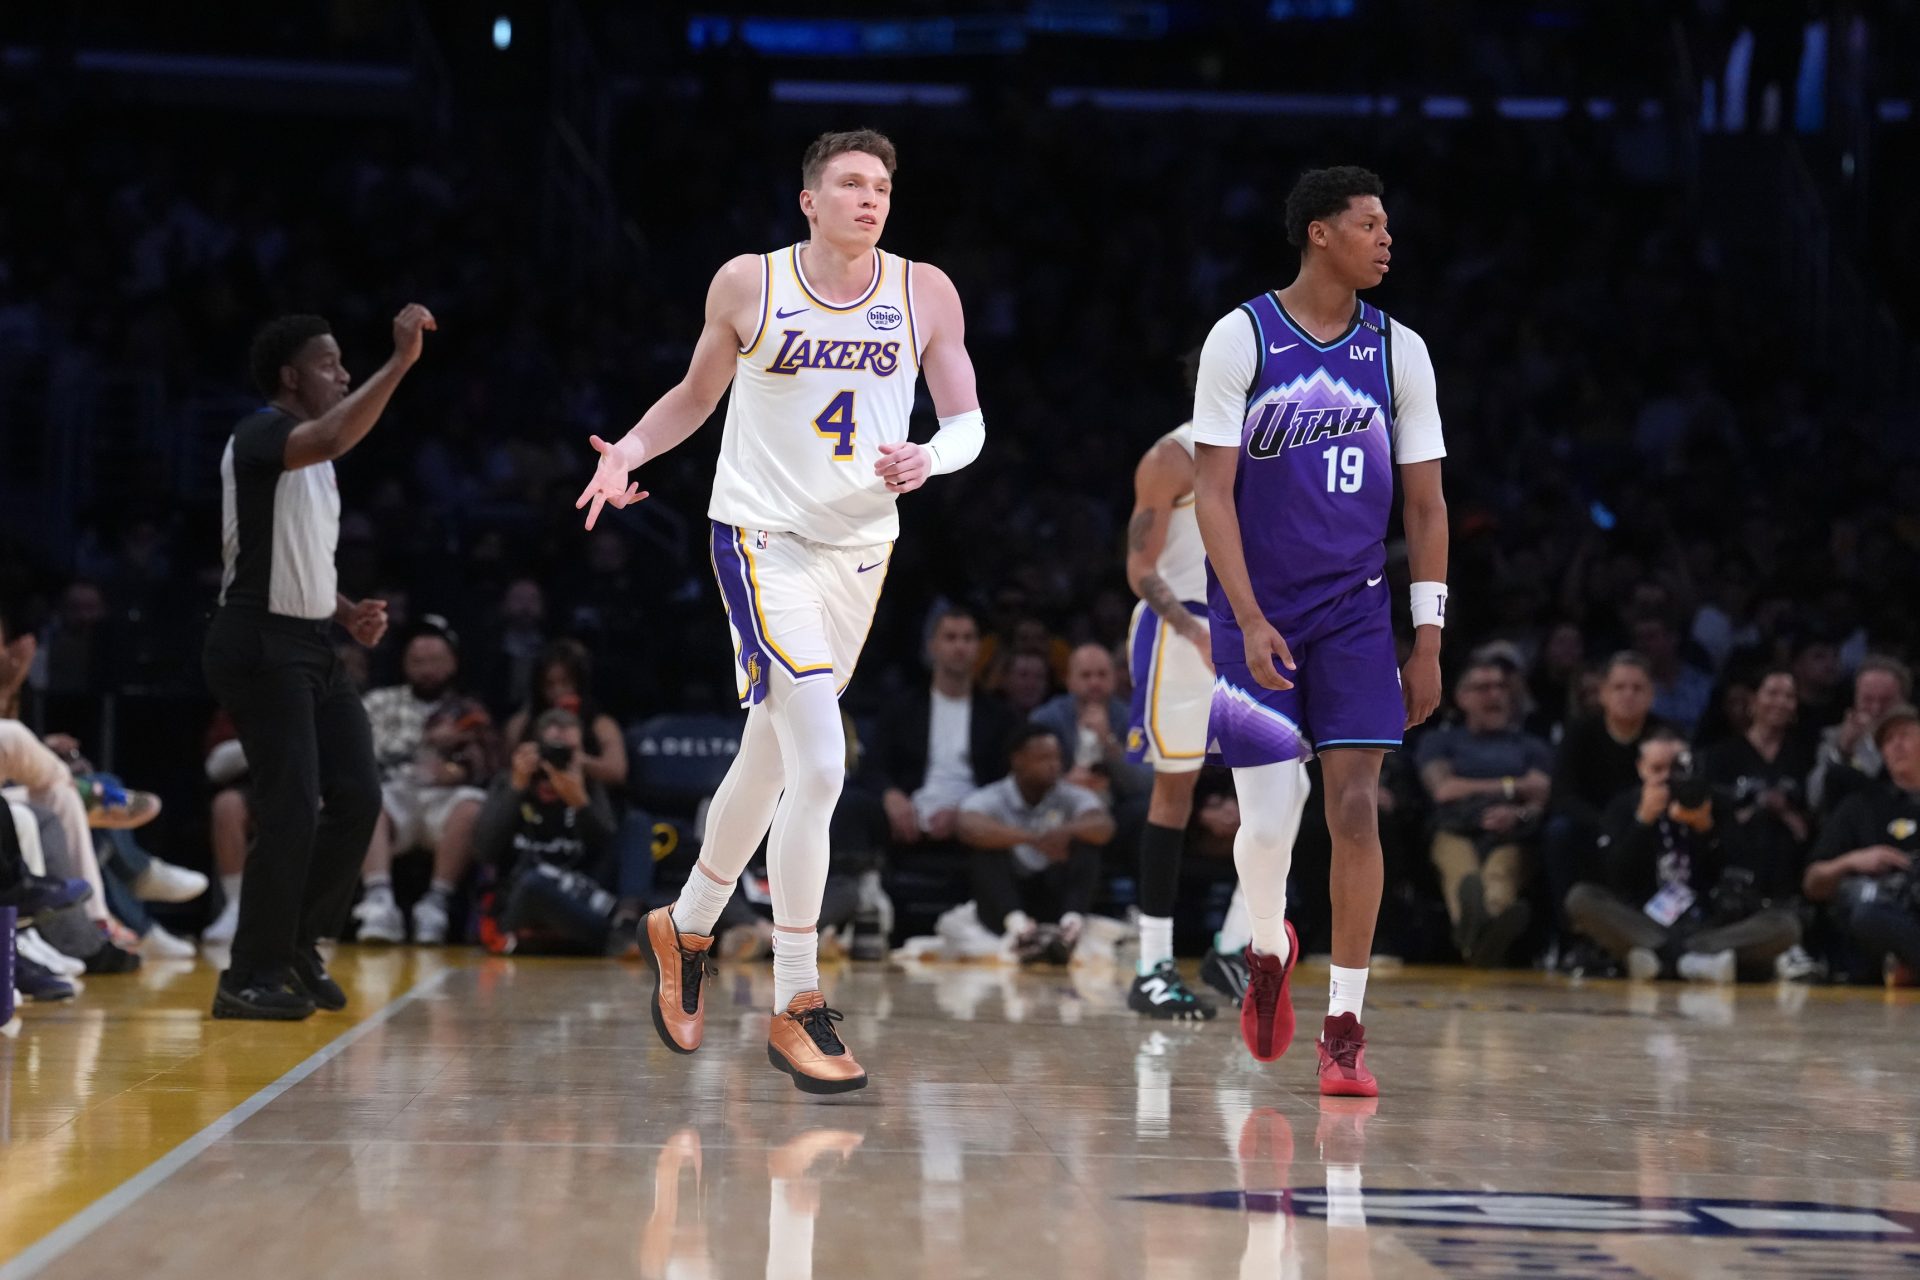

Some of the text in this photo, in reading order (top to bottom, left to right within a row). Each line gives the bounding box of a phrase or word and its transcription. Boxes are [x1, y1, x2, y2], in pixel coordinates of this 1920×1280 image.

[870, 311, 900, 323] bibigo
[765, 329, 900, 378] LAKERS
[1350, 345, 1377, 361] LVT
[811, 389, 857, 462] 4
[1247, 400, 1381, 460] UTAH
[1323, 445, 1364, 494] 19
[661, 736, 740, 757] DELTA
